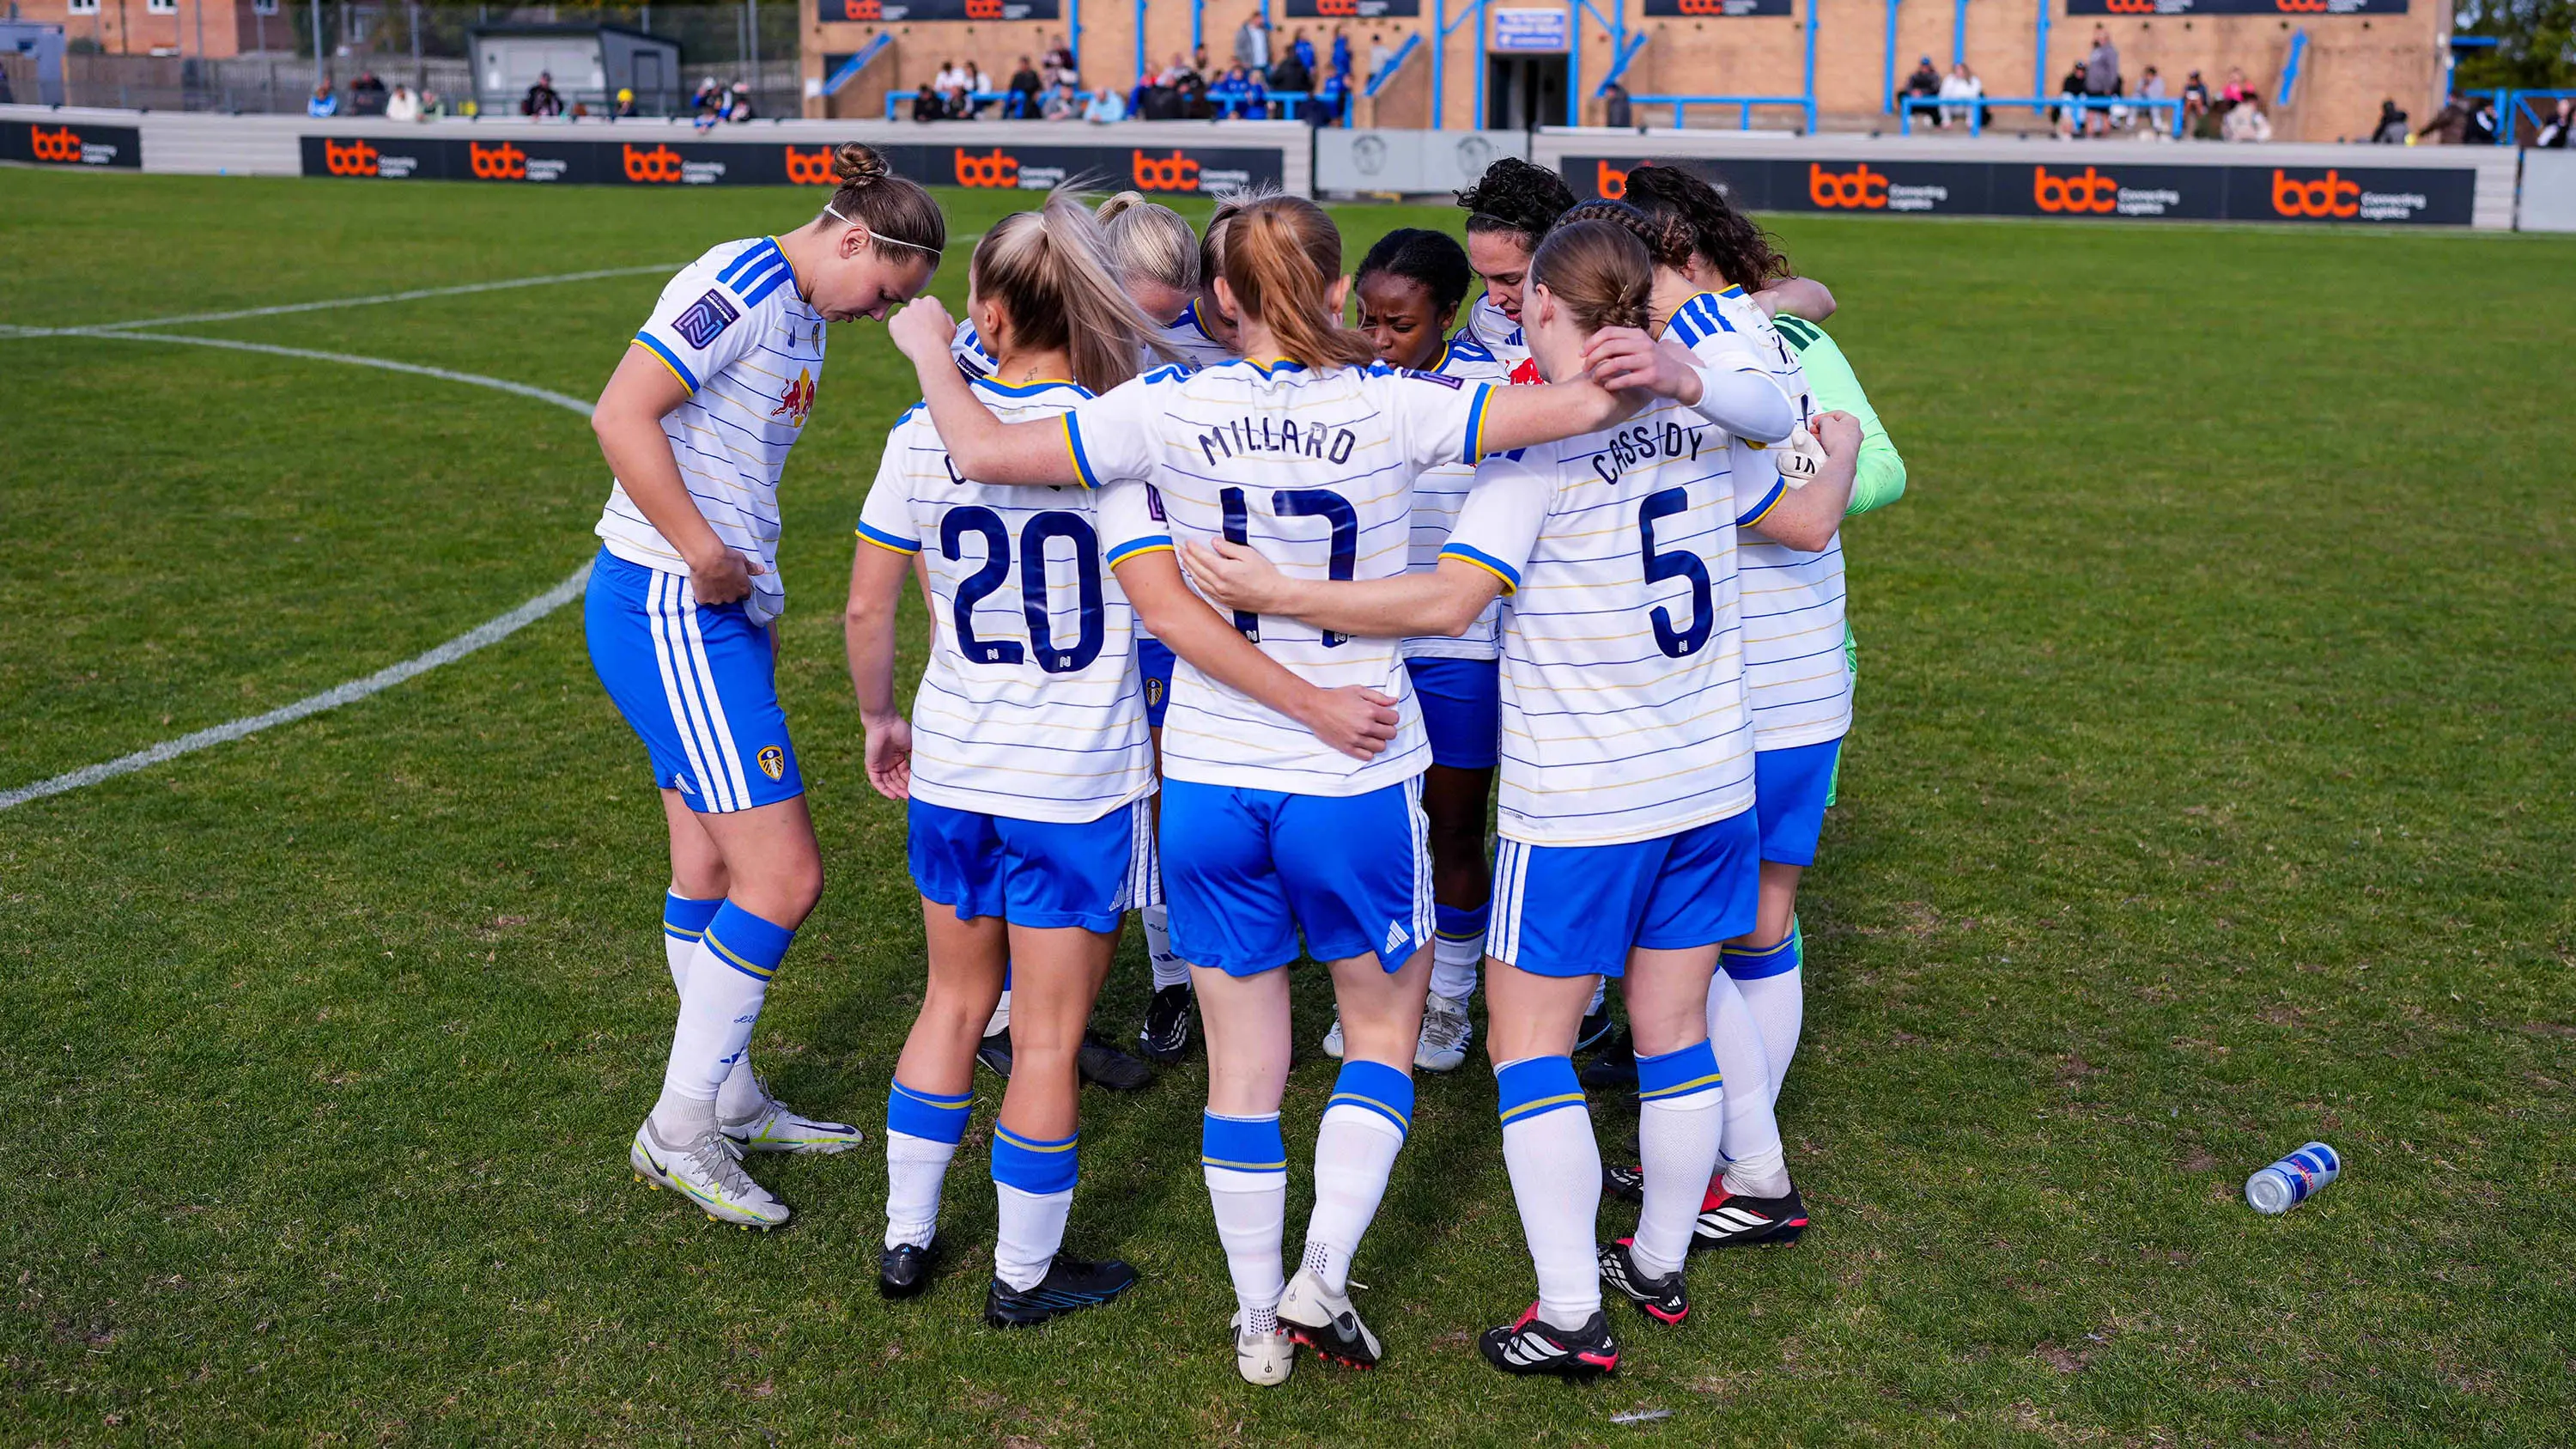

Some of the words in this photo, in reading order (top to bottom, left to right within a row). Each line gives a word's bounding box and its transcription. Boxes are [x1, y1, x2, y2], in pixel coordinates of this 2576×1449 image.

[32, 125, 81, 161] bdc
[325, 139, 379, 175] bdc
[470, 142, 526, 179] bdc
[623, 144, 682, 181] bdc
[786, 144, 844, 185] bd
[955, 147, 1018, 188] bdc
[1133, 149, 1200, 190] bdc
[1808, 162, 1888, 209] bdc
[2033, 166, 2117, 213] bdc
[2272, 169, 2360, 217] bdc
[1198, 417, 1356, 466] MILLARD
[1592, 421, 1703, 485] CASSIDY
[939, 505, 1105, 673] 20
[1638, 485, 1714, 659] 5
